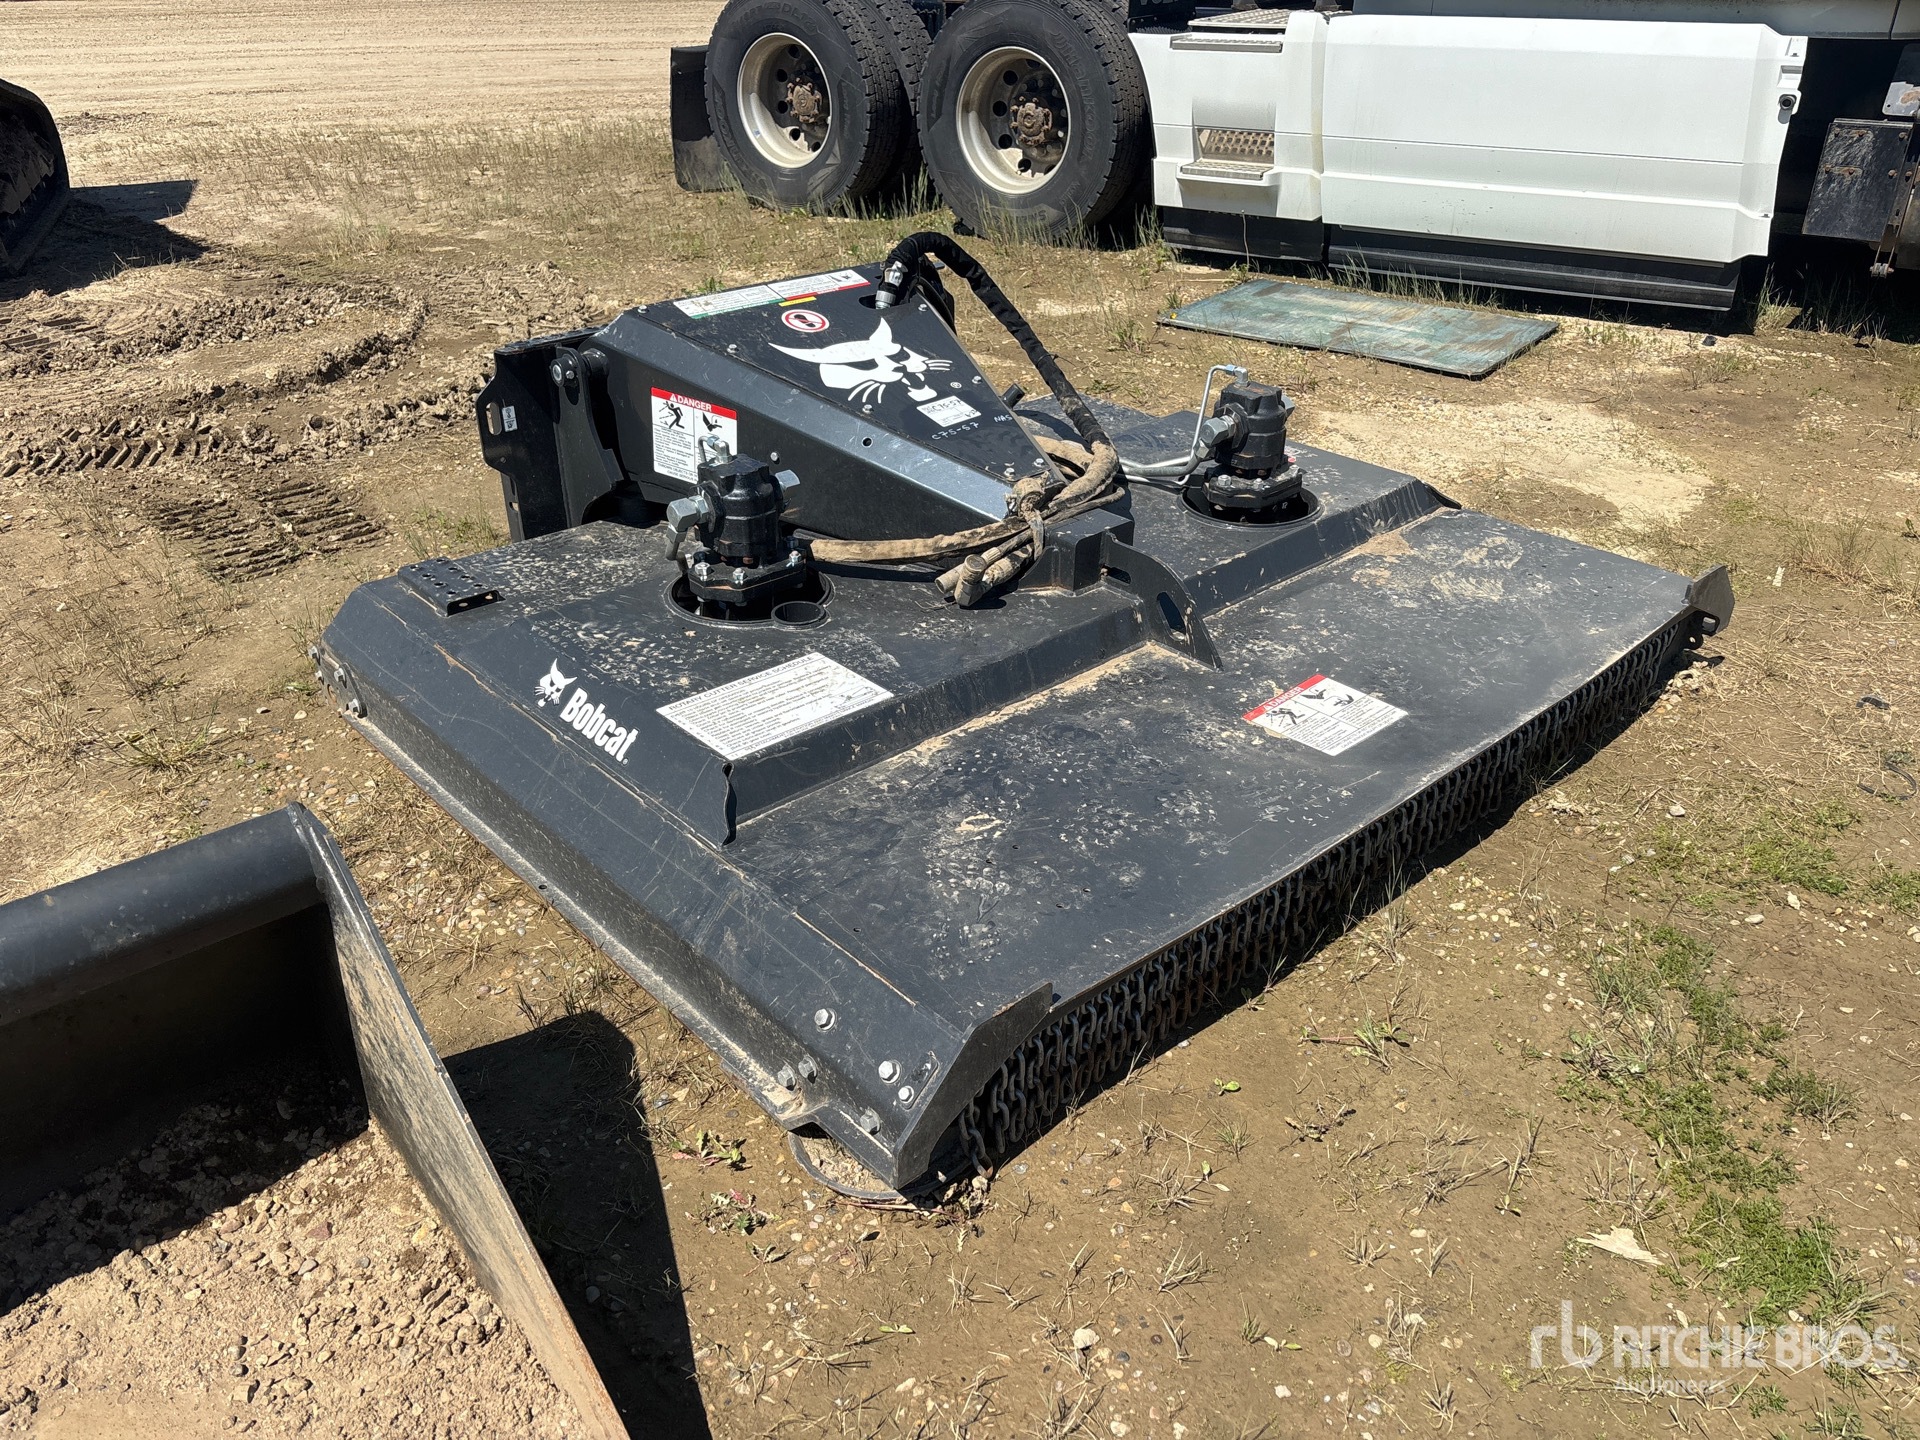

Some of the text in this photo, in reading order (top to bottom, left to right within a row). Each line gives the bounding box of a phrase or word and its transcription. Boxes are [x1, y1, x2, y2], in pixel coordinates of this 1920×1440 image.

[678, 395, 712, 412] DANGER
[669, 655, 814, 711] ROTARY CUTTER SERVICE SCHEDULE
[1269, 686, 1304, 708] DANGER
[559, 687, 639, 762] Bobcat
